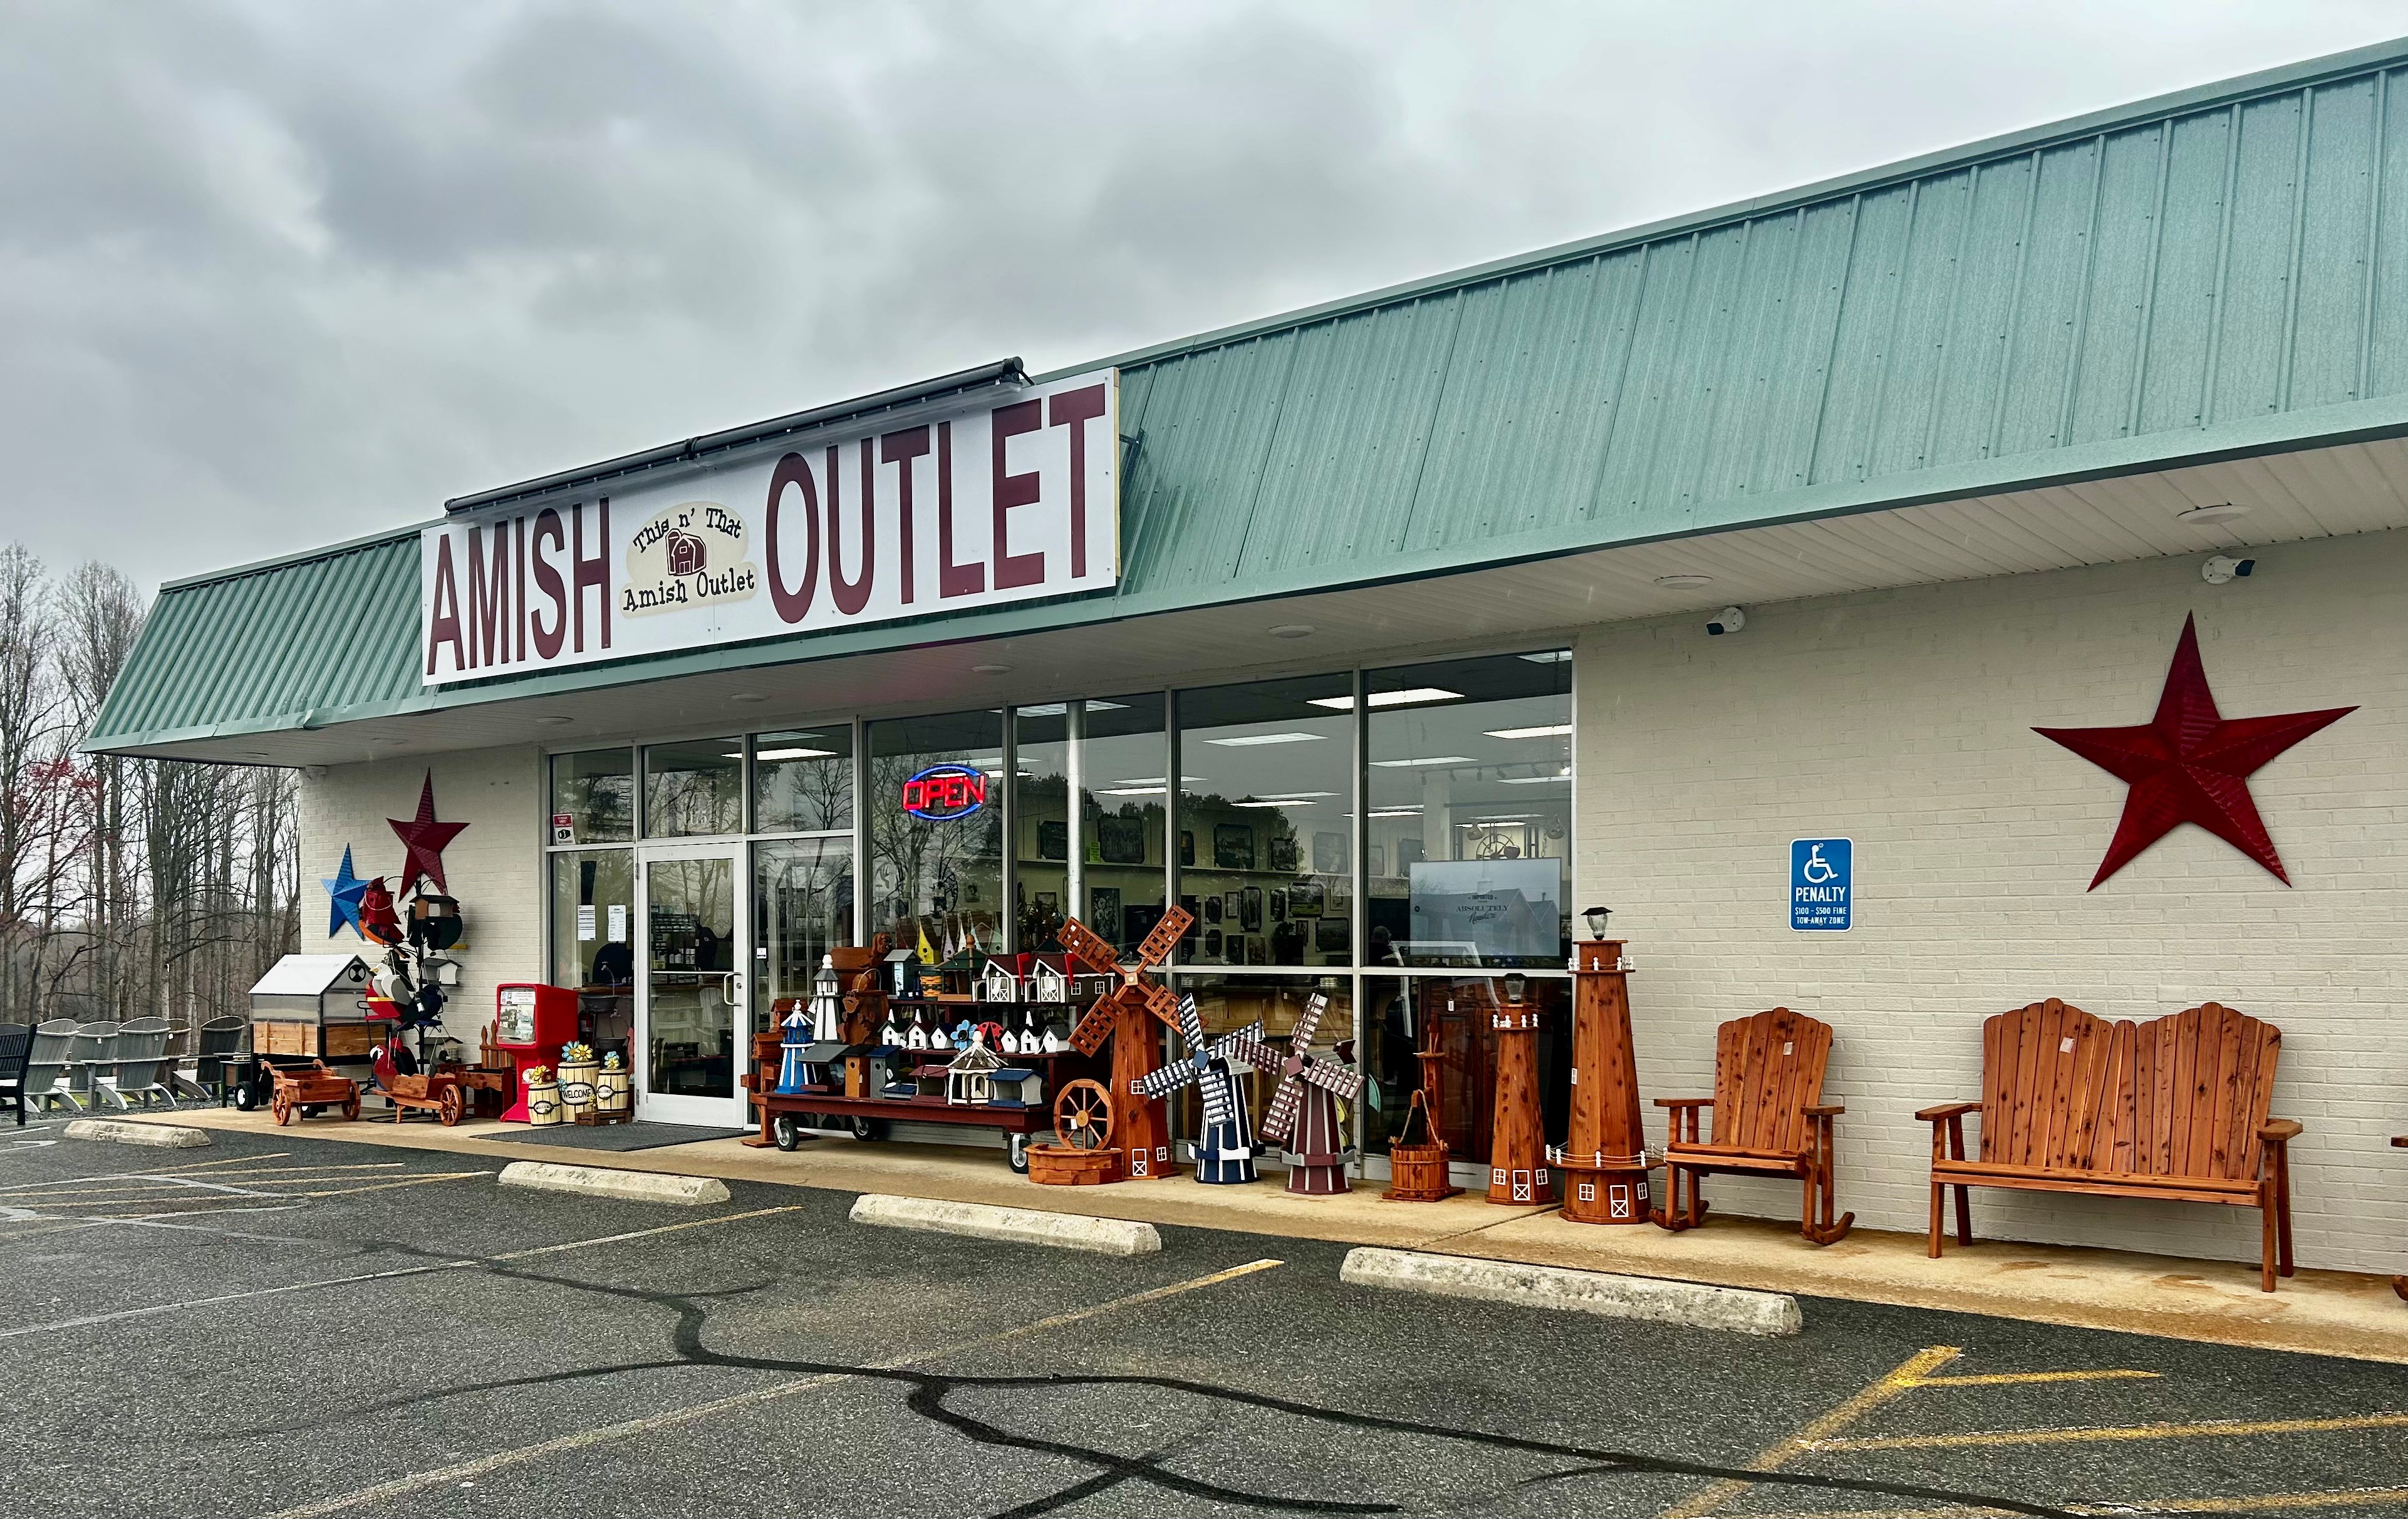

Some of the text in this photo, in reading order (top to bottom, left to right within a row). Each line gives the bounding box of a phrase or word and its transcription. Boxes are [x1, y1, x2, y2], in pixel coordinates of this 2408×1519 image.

[427, 383, 1106, 675] AMISH OUTLET
[633, 507, 742, 553] This n' That
[623, 568, 755, 612] Amish Outlet
[902, 775, 985, 811] OPEN
[1795, 887, 1846, 902] PENALTY
[1795, 906, 1809, 915] $100
[1815, 906, 1831, 915] $500
[1797, 916, 1845, 925] TOW-AWAY ZONE
[564, 1088, 591, 1099] WELCOME
